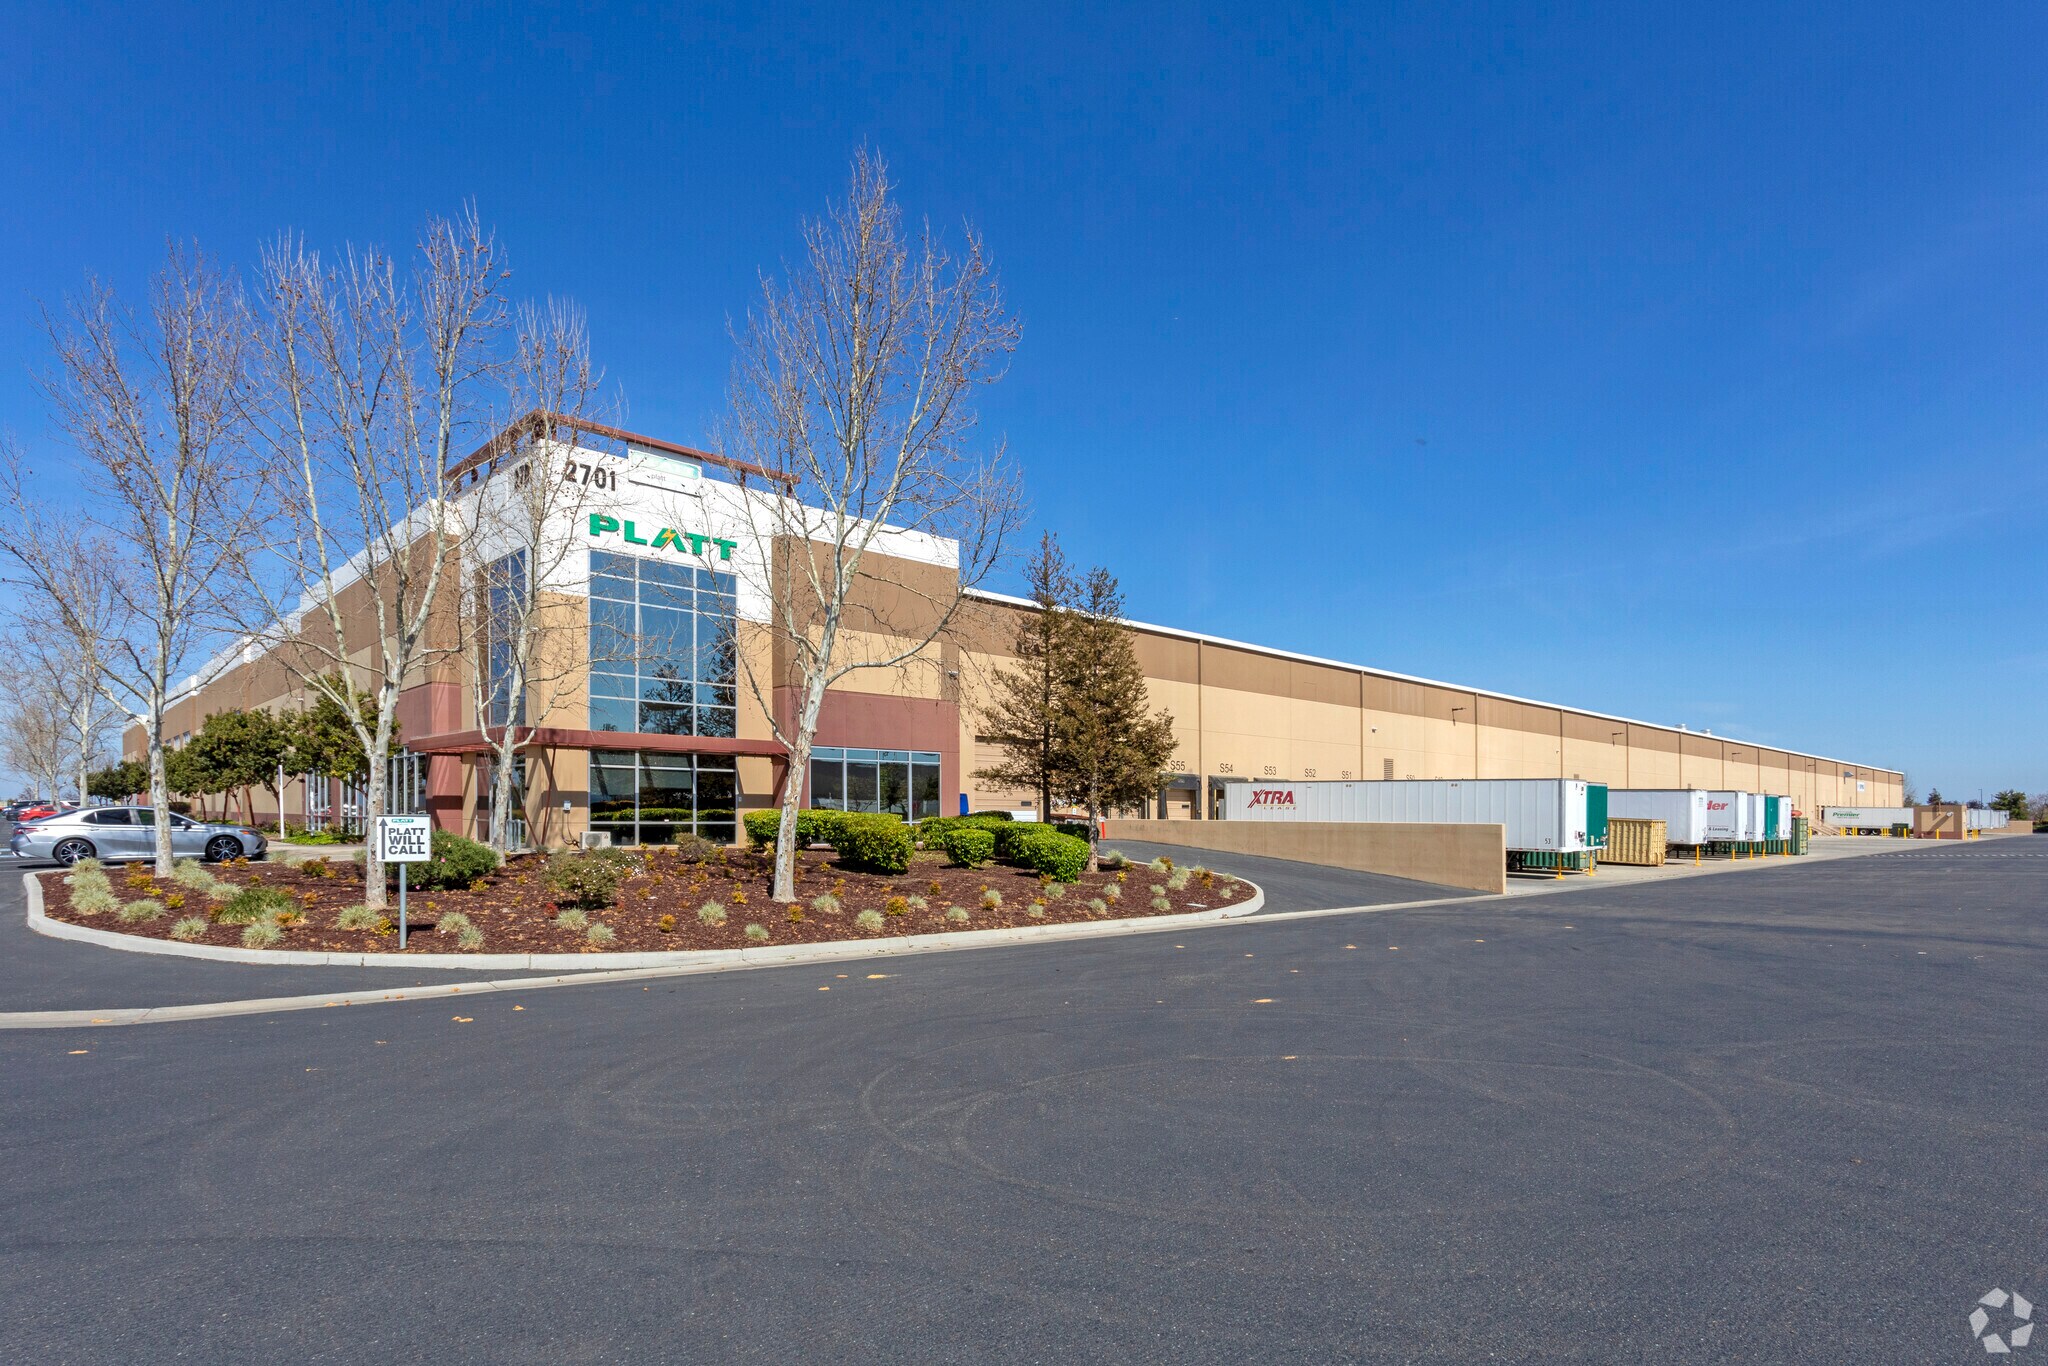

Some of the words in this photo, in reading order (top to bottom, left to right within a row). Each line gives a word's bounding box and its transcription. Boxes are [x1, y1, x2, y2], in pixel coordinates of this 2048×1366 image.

[565, 460, 615, 491] 2701
[589, 513, 738, 561] PLATT
[1170, 760, 1186, 771] S55
[1219, 763, 1234, 773] S54
[1263, 765, 1277, 776] S53
[1304, 768, 1317, 778] S52
[1341, 770, 1352, 780] S51
[1247, 789, 1294, 808] XTRA
[388, 836, 425, 845] WILL
[388, 846, 426, 855] CALL
